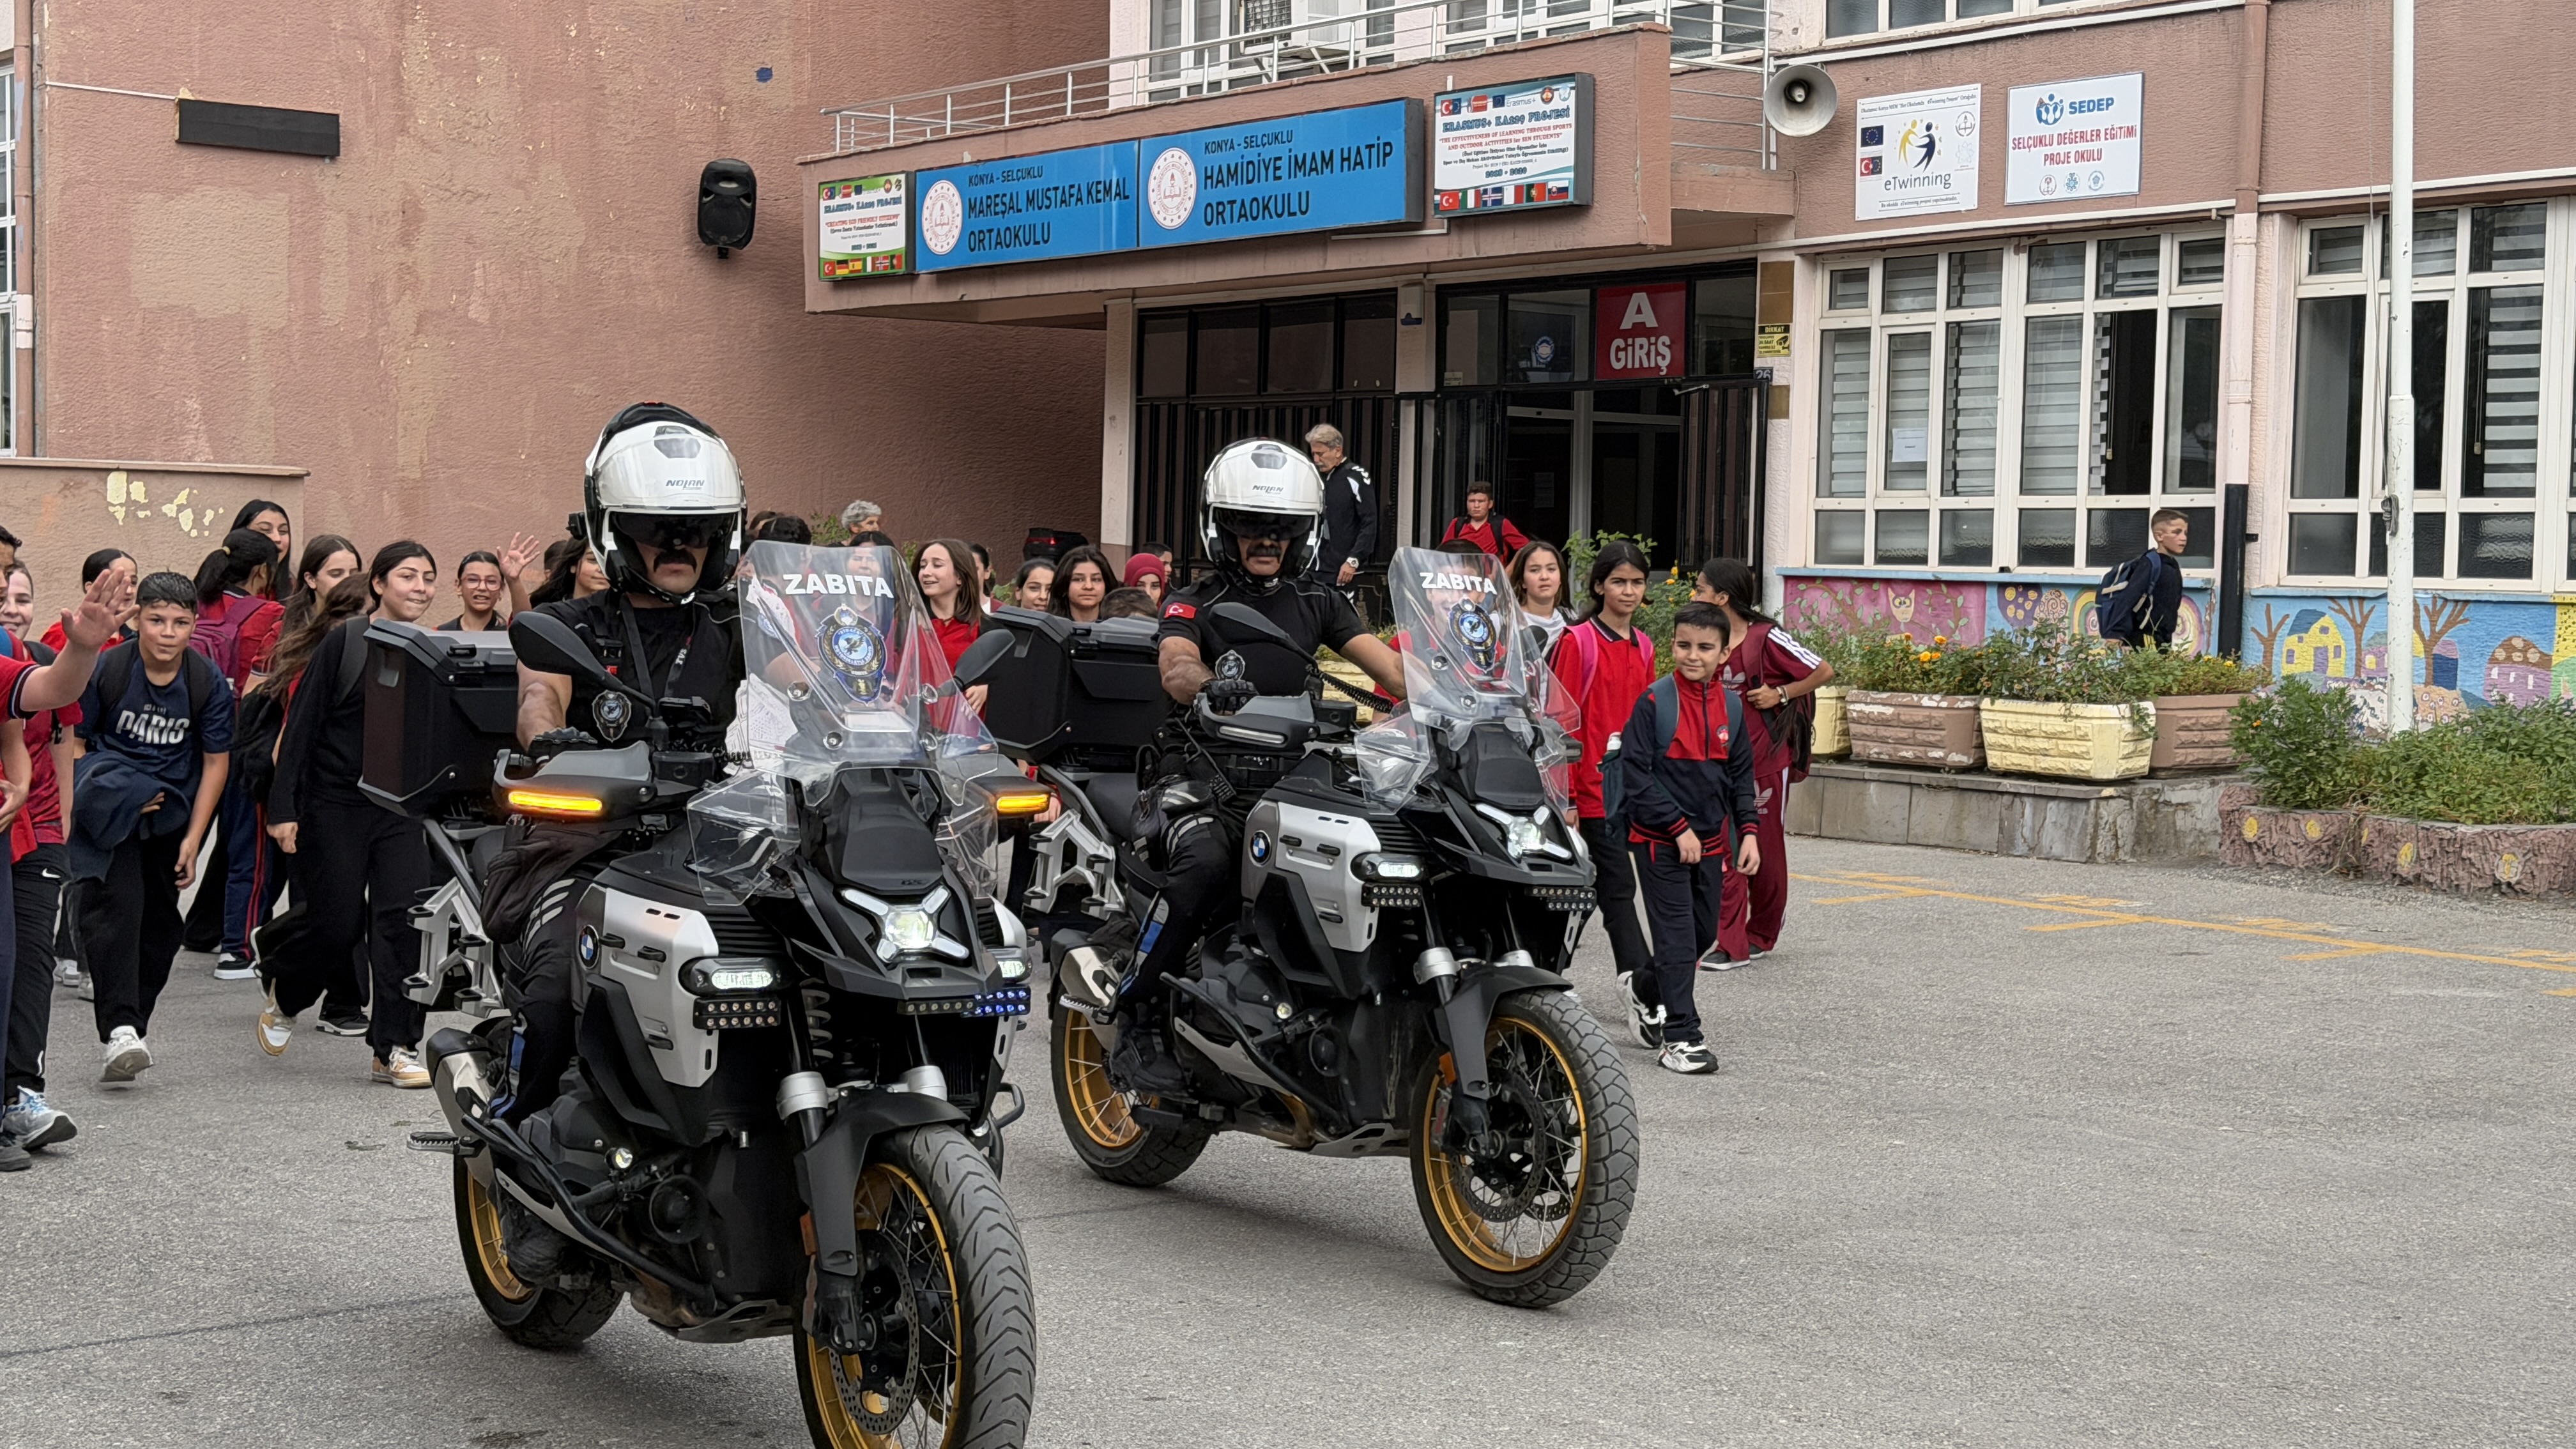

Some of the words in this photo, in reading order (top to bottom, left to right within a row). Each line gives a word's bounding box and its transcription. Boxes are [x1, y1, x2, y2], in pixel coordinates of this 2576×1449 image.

[1506, 97, 1536, 107] Erasmus+
[2068, 97, 2114, 115] SEDEP
[1443, 118, 1492, 133] ERASMUS+
[1528, 105, 1570, 123] PROJESİ
[1204, 138, 1235, 155] KONYA
[1243, 130, 1293, 150] SELÇUKLU
[2011, 132, 2055, 153] SELÇUKLU
[2057, 125, 2101, 148] DEĞERLER
[1204, 153, 1282, 190] HAMİDİYE
[1287, 147, 1334, 180] İMAM
[1340, 135, 1393, 173] HATİP
[2043, 150, 2072, 167] PROJE
[2074, 147, 2103, 163] OKULU
[968, 172, 994, 188] KONYA
[1001, 165, 1043, 185] SELÇUKLU
[1884, 171, 1952, 191] eTwinning
[968, 190, 1022, 220] MAREŞAL
[1025, 183, 1084, 213] MUSTAFA
[1087, 177, 1130, 206] KEMAL
[1203, 190, 1310, 226] ORTAOKULU
[968, 221, 1050, 252] ORTAOKULU
[1620, 291, 1659, 330] A
[1765, 325, 1785, 334] DİKKAT
[665, 479, 705, 490] NOLAN
[1252, 484, 1284, 494] NOLAN
[783, 573, 894, 599] ZABITA
[1419, 571, 1498, 595] ZABITA
[675, 648, 687, 665] TVS
[115, 709, 190, 745] PARIS
